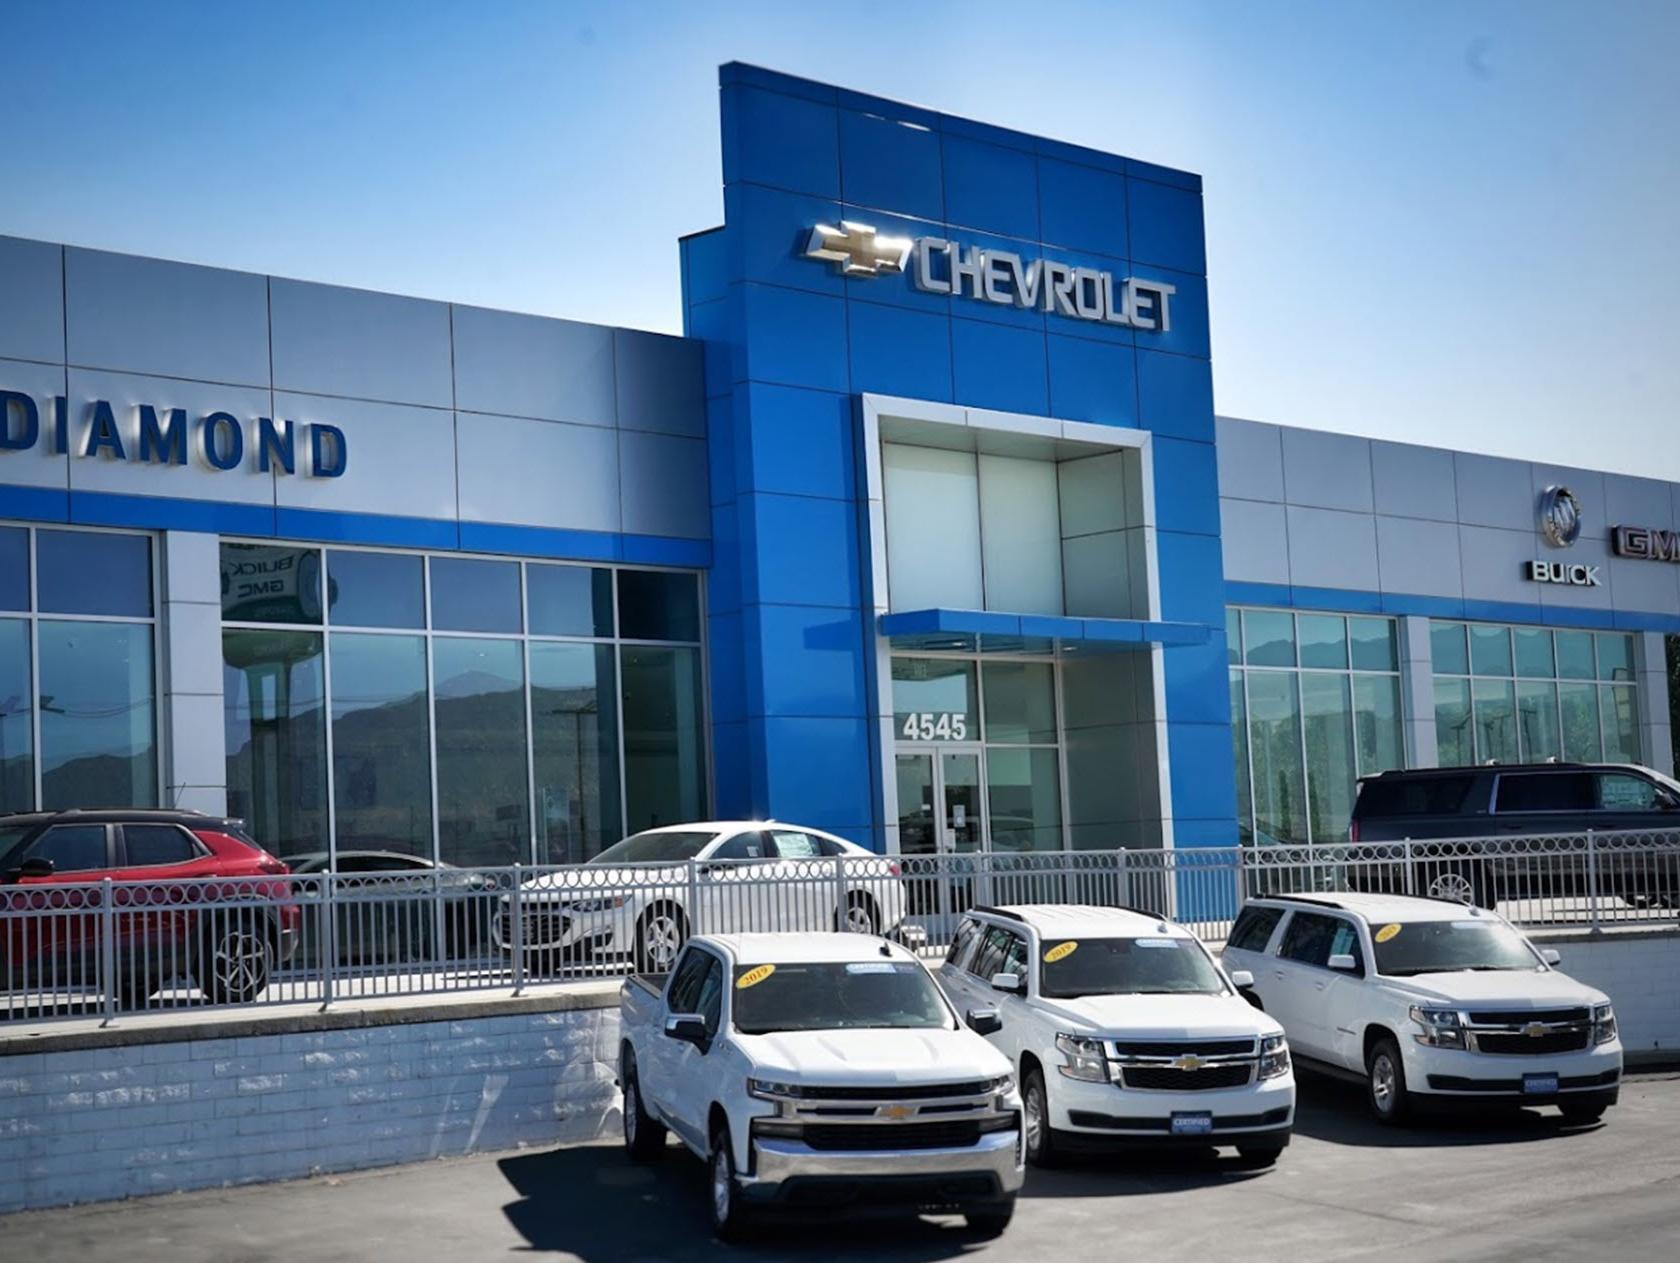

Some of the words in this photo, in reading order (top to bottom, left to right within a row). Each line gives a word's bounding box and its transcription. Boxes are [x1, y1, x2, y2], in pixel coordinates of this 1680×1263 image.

[915, 236, 1176, 332] CHEVROLET
[0, 390, 347, 478] DIAMOND
[1612, 525, 1680, 562] GM
[1531, 560, 1602, 586] BUICK
[903, 713, 967, 740] 4545
[744, 967, 768, 985] 2019
